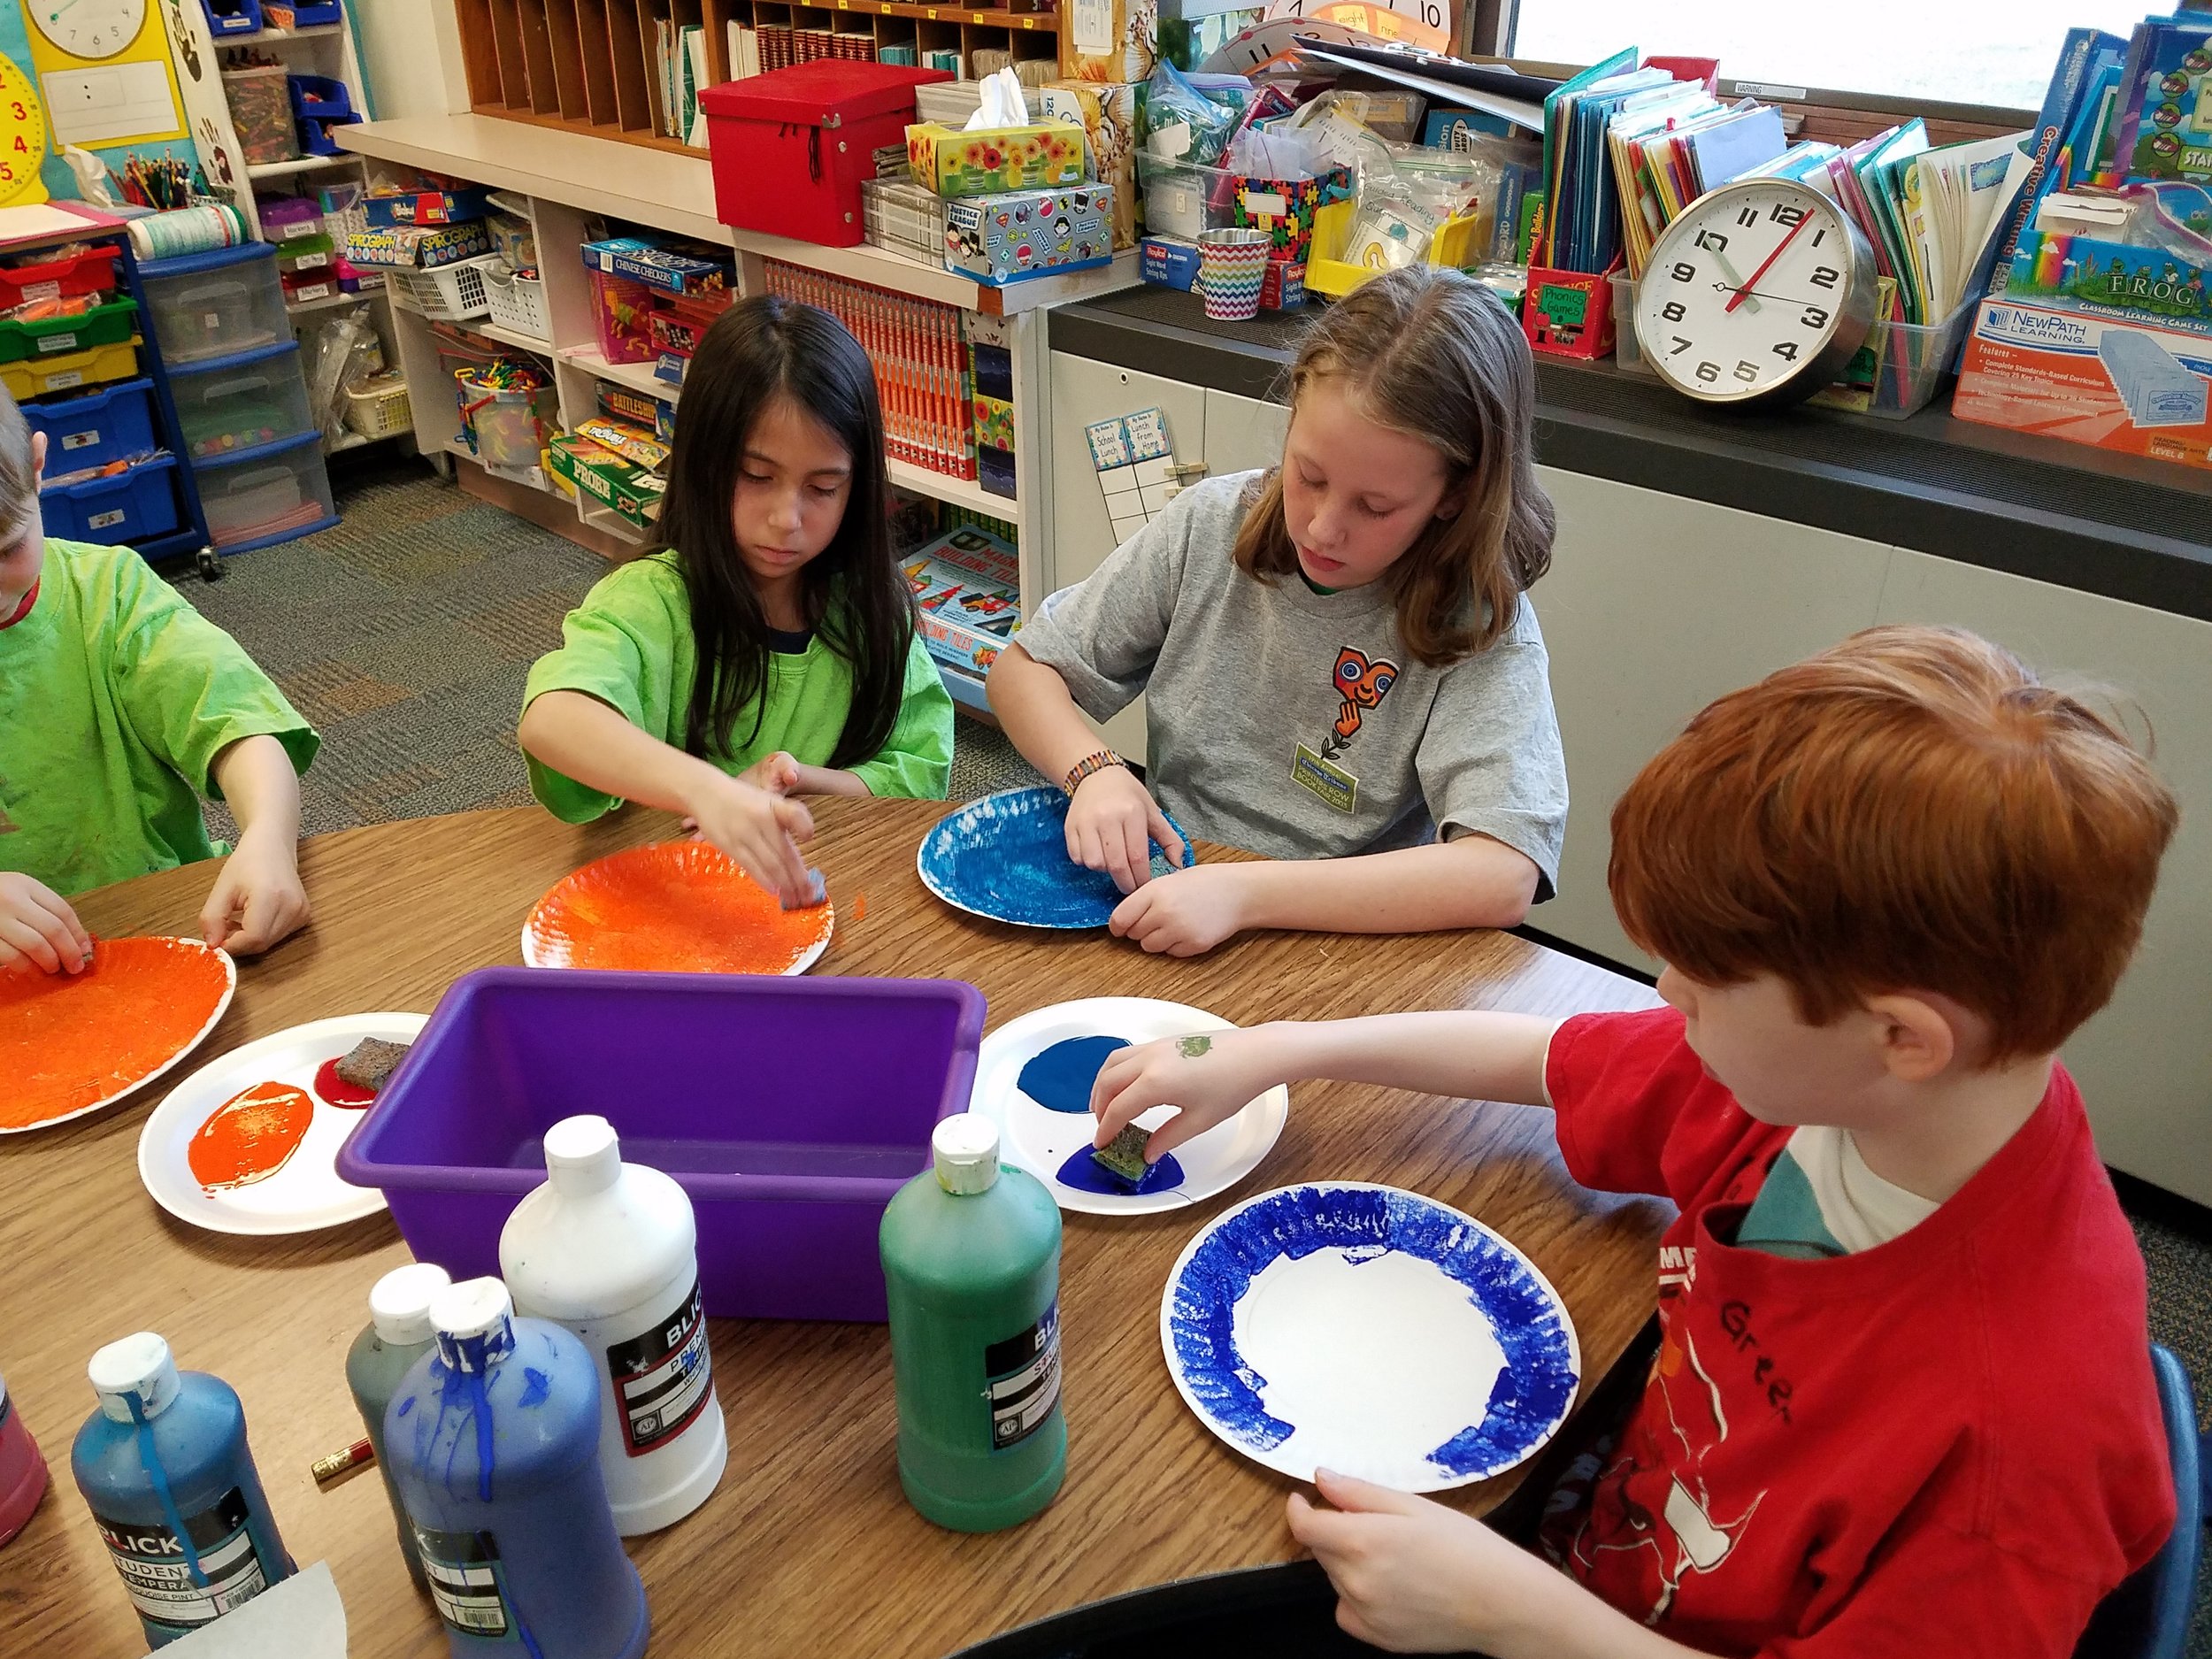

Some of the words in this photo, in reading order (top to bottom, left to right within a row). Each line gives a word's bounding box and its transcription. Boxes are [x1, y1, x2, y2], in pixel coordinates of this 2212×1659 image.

[1339, 12, 1365, 27] eight
[1421, 0, 1440, 28] 10
[70, 29, 77, 41] 7
[93, 35, 101, 45] 6
[111, 26, 119, 37] 5
[1381, 25, 1399, 38] nine
[1248, 43, 1272, 64] 11
[1737, 84, 1763, 94] WARNING
[11, 102, 27, 120] 3
[14, 135, 27, 153] 4
[0, 162, 13, 180] 5
[2024, 126, 2058, 196] Creative
[949, 204, 979, 219] JUSTICE
[1363, 182, 1394, 198] Guided
[1401, 195, 1435, 225] Reading
[949, 214, 977, 227] LEAGUE
[1530, 202, 1544, 235] Builders
[1737, 207, 1759, 227] 11
[1769, 204, 1805, 227] 12
[422, 222, 485, 252] SPIROGRAPH
[2001, 199, 2035, 257] Writing
[348, 233, 397, 249] SPIROGRAPH
[1694, 229, 1729, 253] 10
[1811, 229, 1825, 248] 1
[615, 259, 641, 275] CHINESE
[640, 265, 672, 283] CHECKERS
[1671, 262, 1696, 282] 9
[1809, 266, 1839, 289] 2
[1545, 288, 1584, 305] Phonics
[2112, 275, 2192, 304] FROG
[1547, 301, 1580, 317] Games
[1662, 301, 1686, 322] 8
[1801, 307, 1829, 329] 3
[2079, 303, 2124, 317] CLASSROOM
[2125, 312, 2167, 325] LEARNING
[2168, 319, 2192, 329] GAME
[2193, 323, 2208, 332] SET
[1670, 335, 1693, 355] 7
[1772, 342, 1799, 361] 4
[1978, 344, 2010, 357] Features
[1695, 361, 1721, 382] 6
[1732, 359, 1760, 382] 5
[1983, 366, 2010, 378] Covering
[2020, 373, 2032, 382] Key
[2034, 375, 2054, 385] Topics
[1985, 358, 2015, 370] Complete
[2015, 365, 2069, 380] Standards-Based
[2069, 374, 2105, 388] Curriculum
[612, 392, 656, 419] BATTLESHIP
[588, 426, 628, 446] TROUBLE
[1132, 422, 1150, 433] Lunch
[1137, 431, 1153, 441] from
[1097, 434, 1116, 446] School
[1100, 447, 1118, 457] Lunch
[2151, 446, 2175, 458] LEVEL
[572, 458, 611, 500] PROBE
[934, 546, 993, 572] BUILDING
[949, 632, 973, 651] TILES
[1302, 758, 1323, 776] Chicago
[1323, 772, 1347, 790] Tribune
[1320, 763, 1341, 779] Annual
[1297, 771, 1317, 789] BOOK
[1317, 786, 1331, 800] FAIR
[1332, 796, 1348, 809] 2003
[1329, 787, 1349, 802] ROW
[666, 1283, 703, 1348] BLIC
[1721, 1301, 1793, 1425] Green
